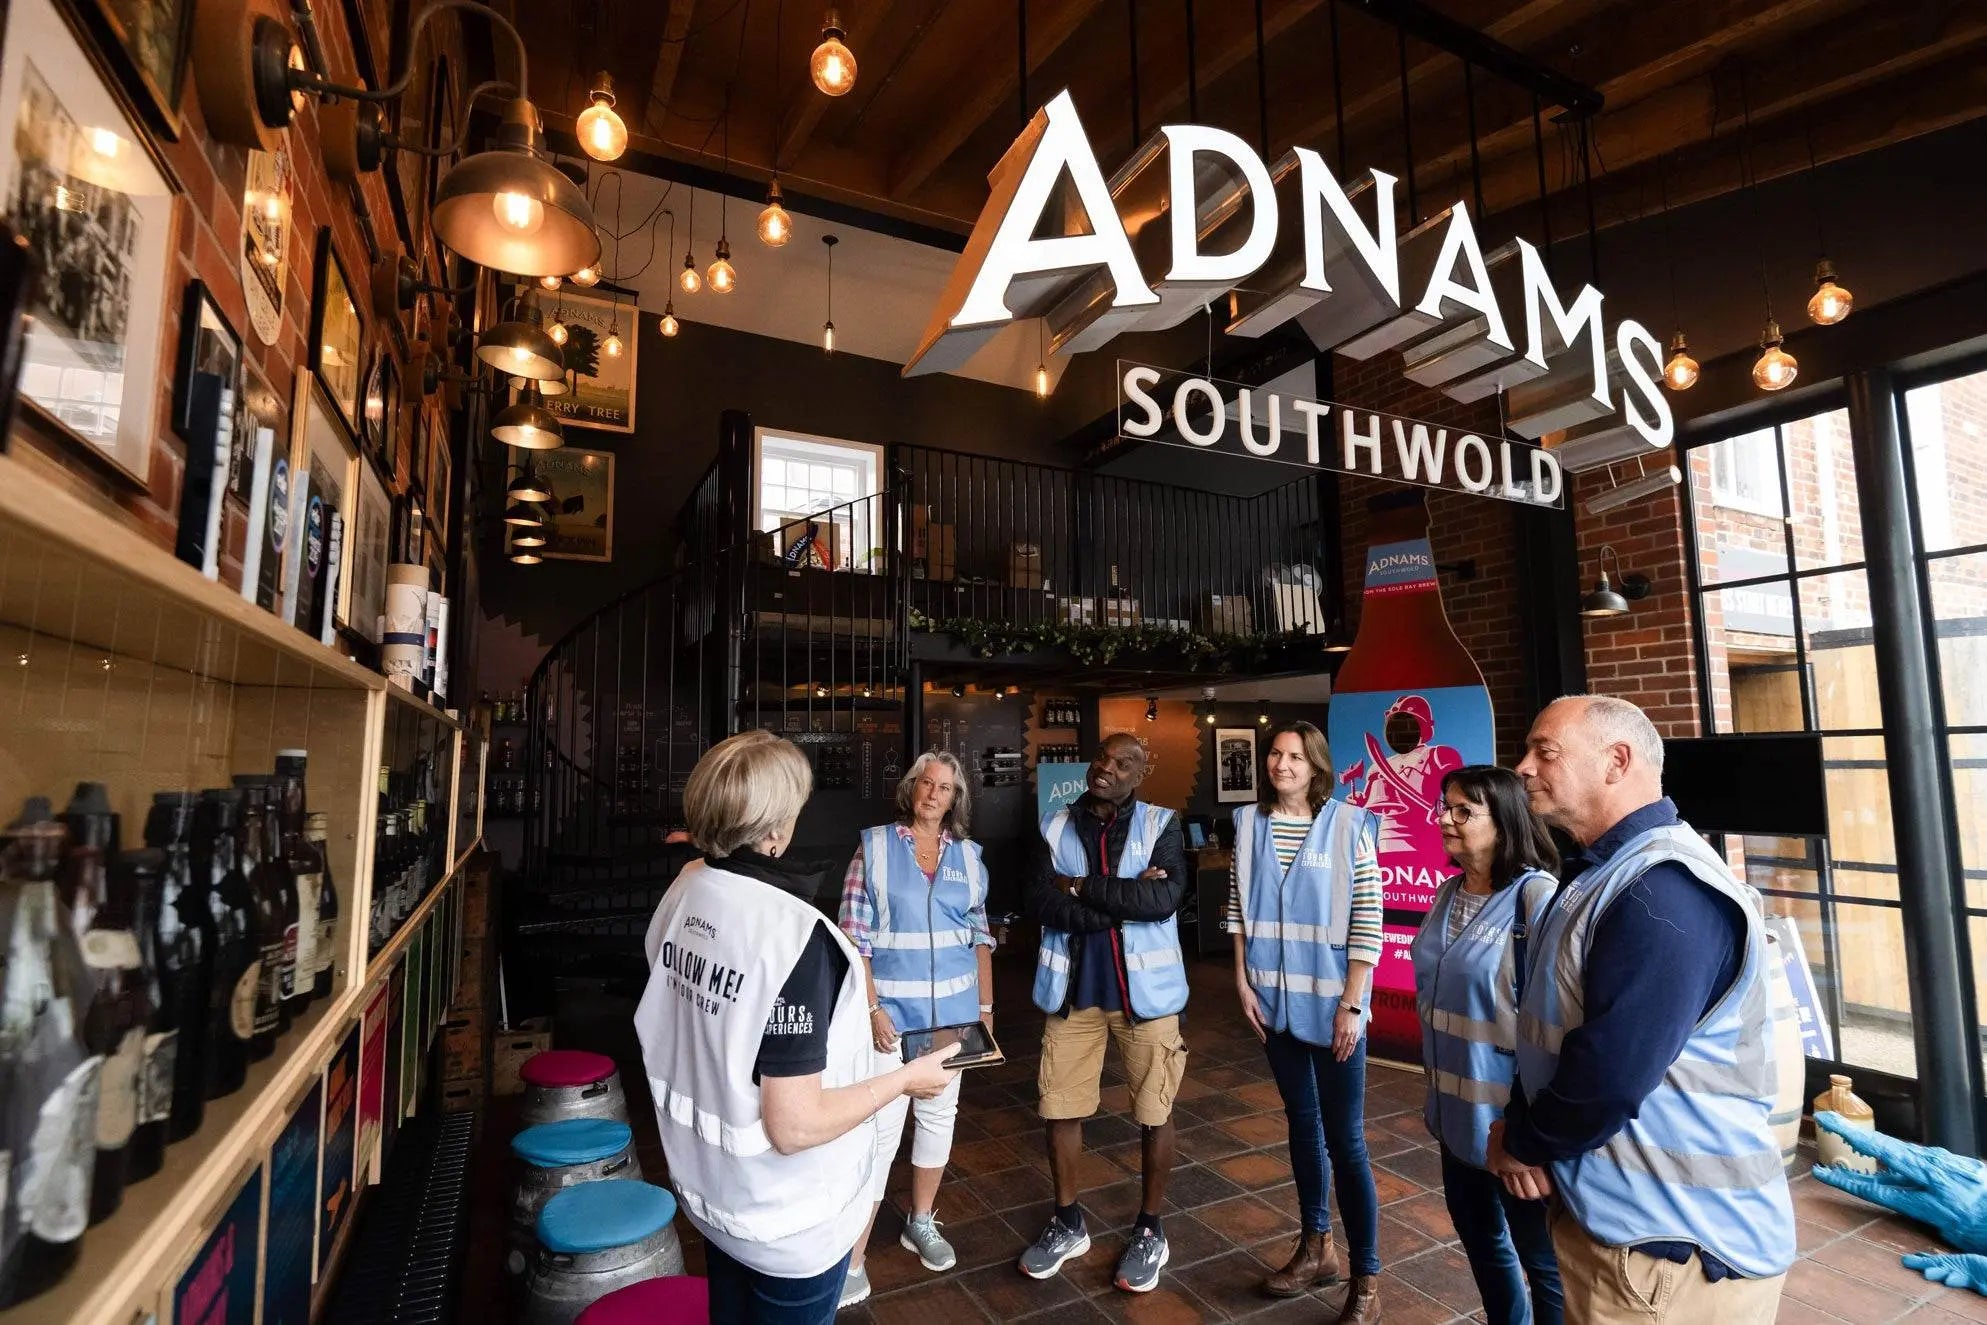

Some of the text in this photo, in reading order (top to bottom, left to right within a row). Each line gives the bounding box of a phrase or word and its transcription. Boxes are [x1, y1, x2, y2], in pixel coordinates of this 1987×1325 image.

[950, 88, 1676, 449] ADNAMS
[547, 399, 621, 420] ERRY TREE
[1122, 366, 1562, 505] SOUTHWOLD
[1368, 554, 1429, 576] ADNAMS
[1048, 778, 1089, 803] ADN
[1379, 865, 1455, 889] DNAM
[1383, 891, 1436, 904] OUTHWO
[684, 916, 716, 939] ADNAMS
[663, 941, 745, 1003] OLLOW ME!
[696, 993, 721, 1016] CREW
[766, 1022, 813, 1035] PERIENCES
